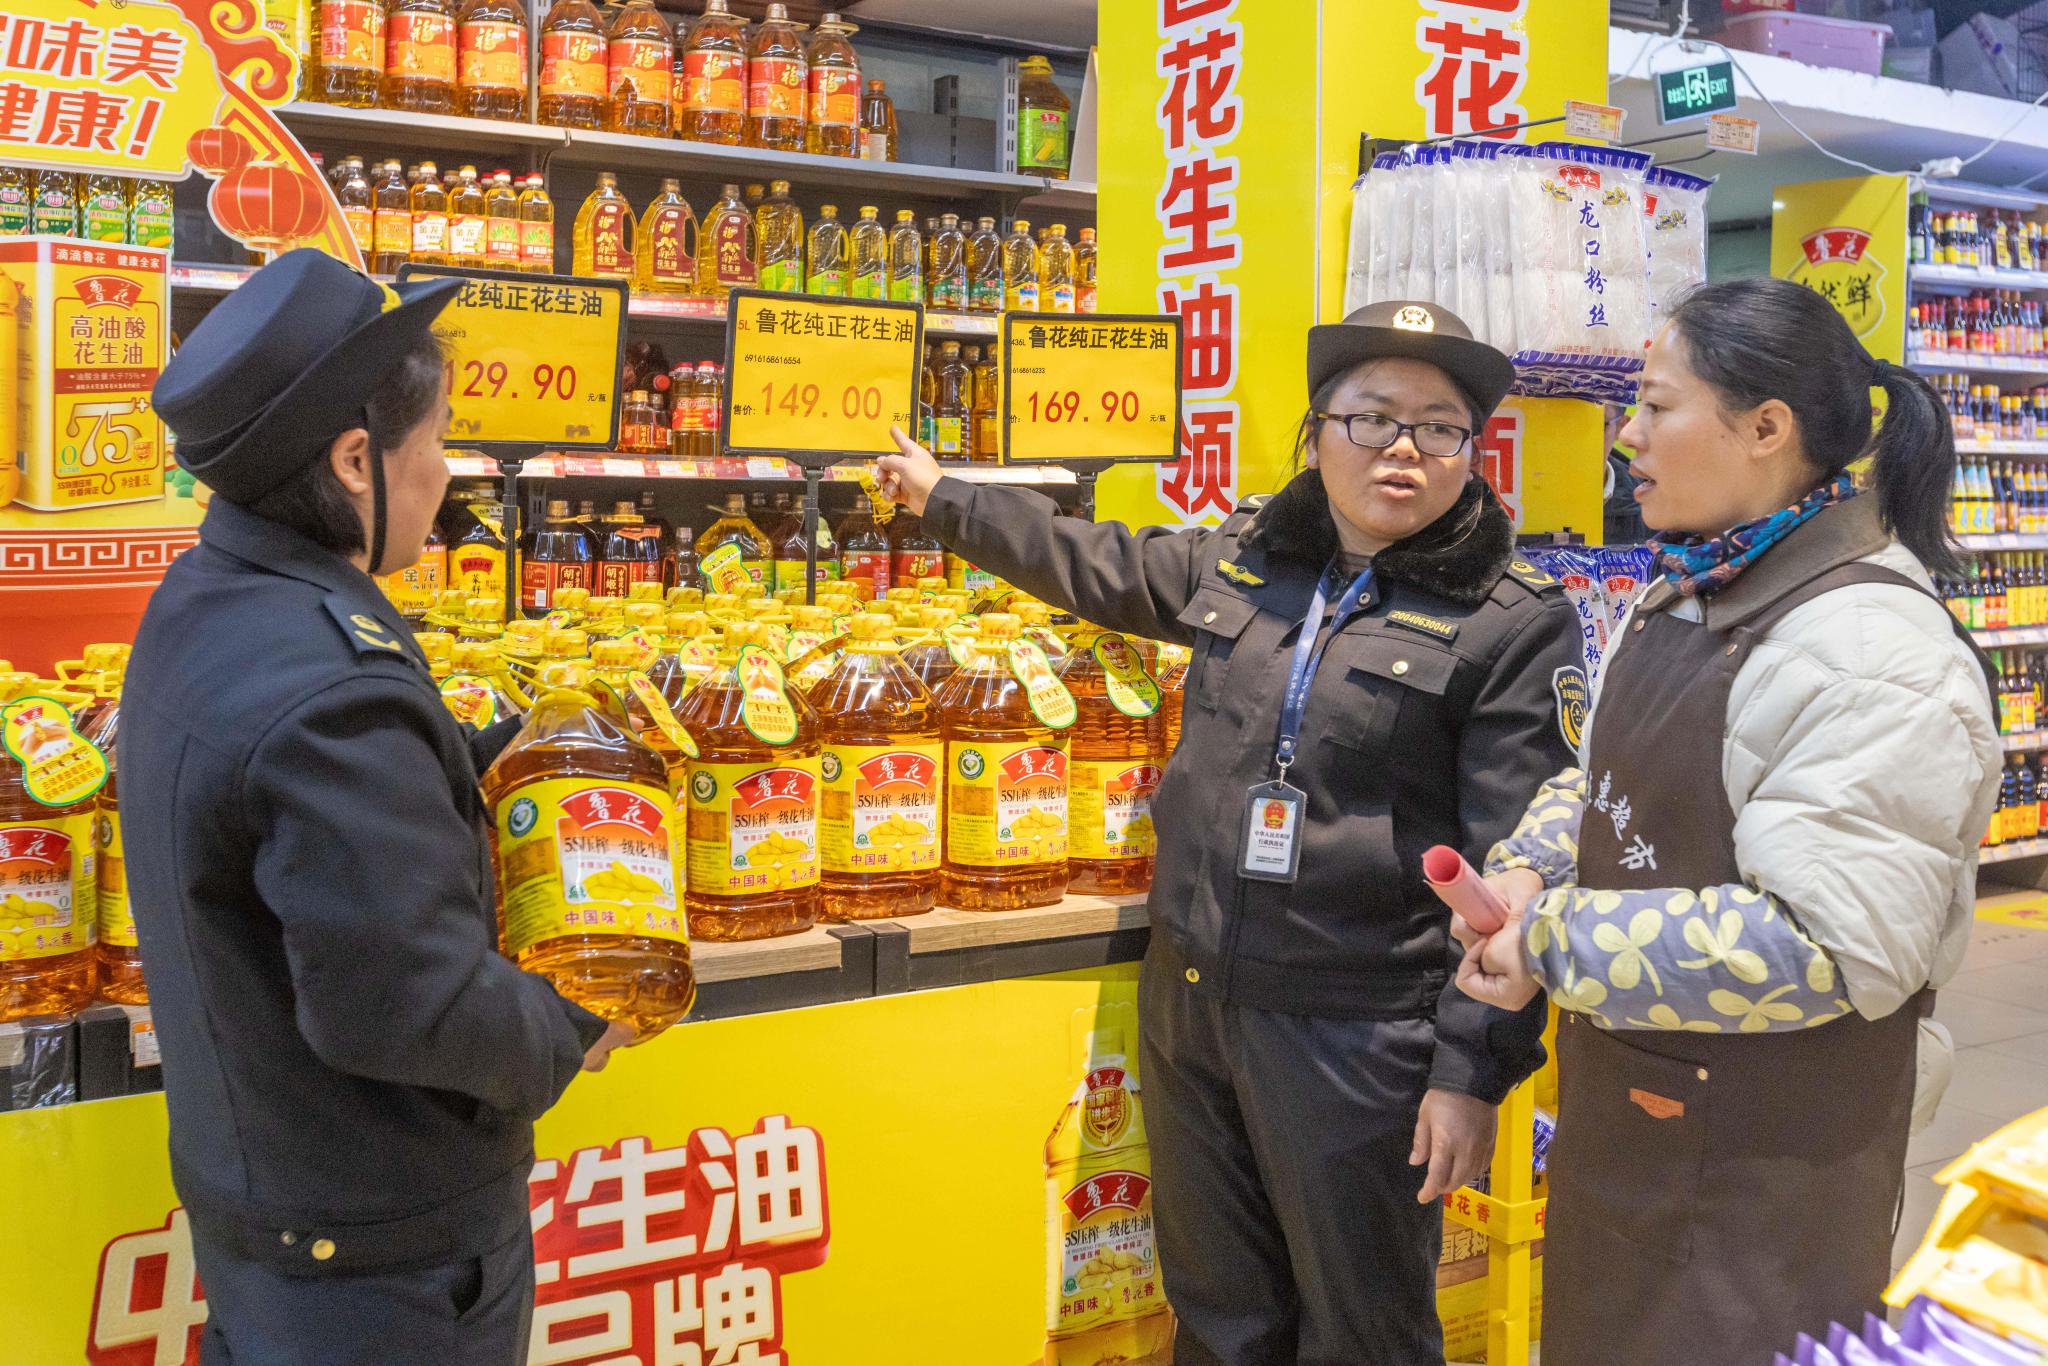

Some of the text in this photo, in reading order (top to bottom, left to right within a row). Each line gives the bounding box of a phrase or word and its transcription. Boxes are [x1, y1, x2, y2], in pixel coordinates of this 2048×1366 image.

[0, 17, 183, 88] 味美
[1425, 0, 1520, 139] 花
[1710, 79, 1728, 96] EXIT
[55, 248, 161, 269] 滴滴鲁花 健康全家
[1162, 0, 1236, 515] 花生油领
[1811, 232, 1860, 260] 鲁花
[1579, 200, 1608, 328] 龙口粉丝
[88, 278, 131, 306] 鲁花
[70, 315, 147, 340] 高油酸
[738, 307, 914, 343] 5L 鲁花纯正花生油
[1028, 325, 1168, 350] 鲁花纯正花生油
[74, 342, 144, 366] 花生油
[744, 354, 801, 365] 6916168616554
[733, 404, 756, 416] 售价:
[761, 382, 882, 421] 149.00
[1028, 391, 1139, 423] 169.90
[1391, 611, 1451, 634] 20040630044
[1576, 596, 1602, 679] 龙口粉
[877, 757, 922, 779] 鲁花
[1017, 752, 1057, 774] 鲁花
[755, 773, 800, 797] 鲁花
[586, 792, 645, 825] 鲁花
[850, 853, 888, 866] 中国味
[995, 846, 1030, 858] 中国味
[1110, 845, 1140, 856] 中国味
[729, 874, 768, 888] 中国味
[564, 910, 616, 926] 中国味
[1083, 1178, 1132, 1209] 鲁花
[1064, 1213, 1151, 1248] 5S压榨 一级花生油
[1060, 1295, 1099, 1318] 中国味
